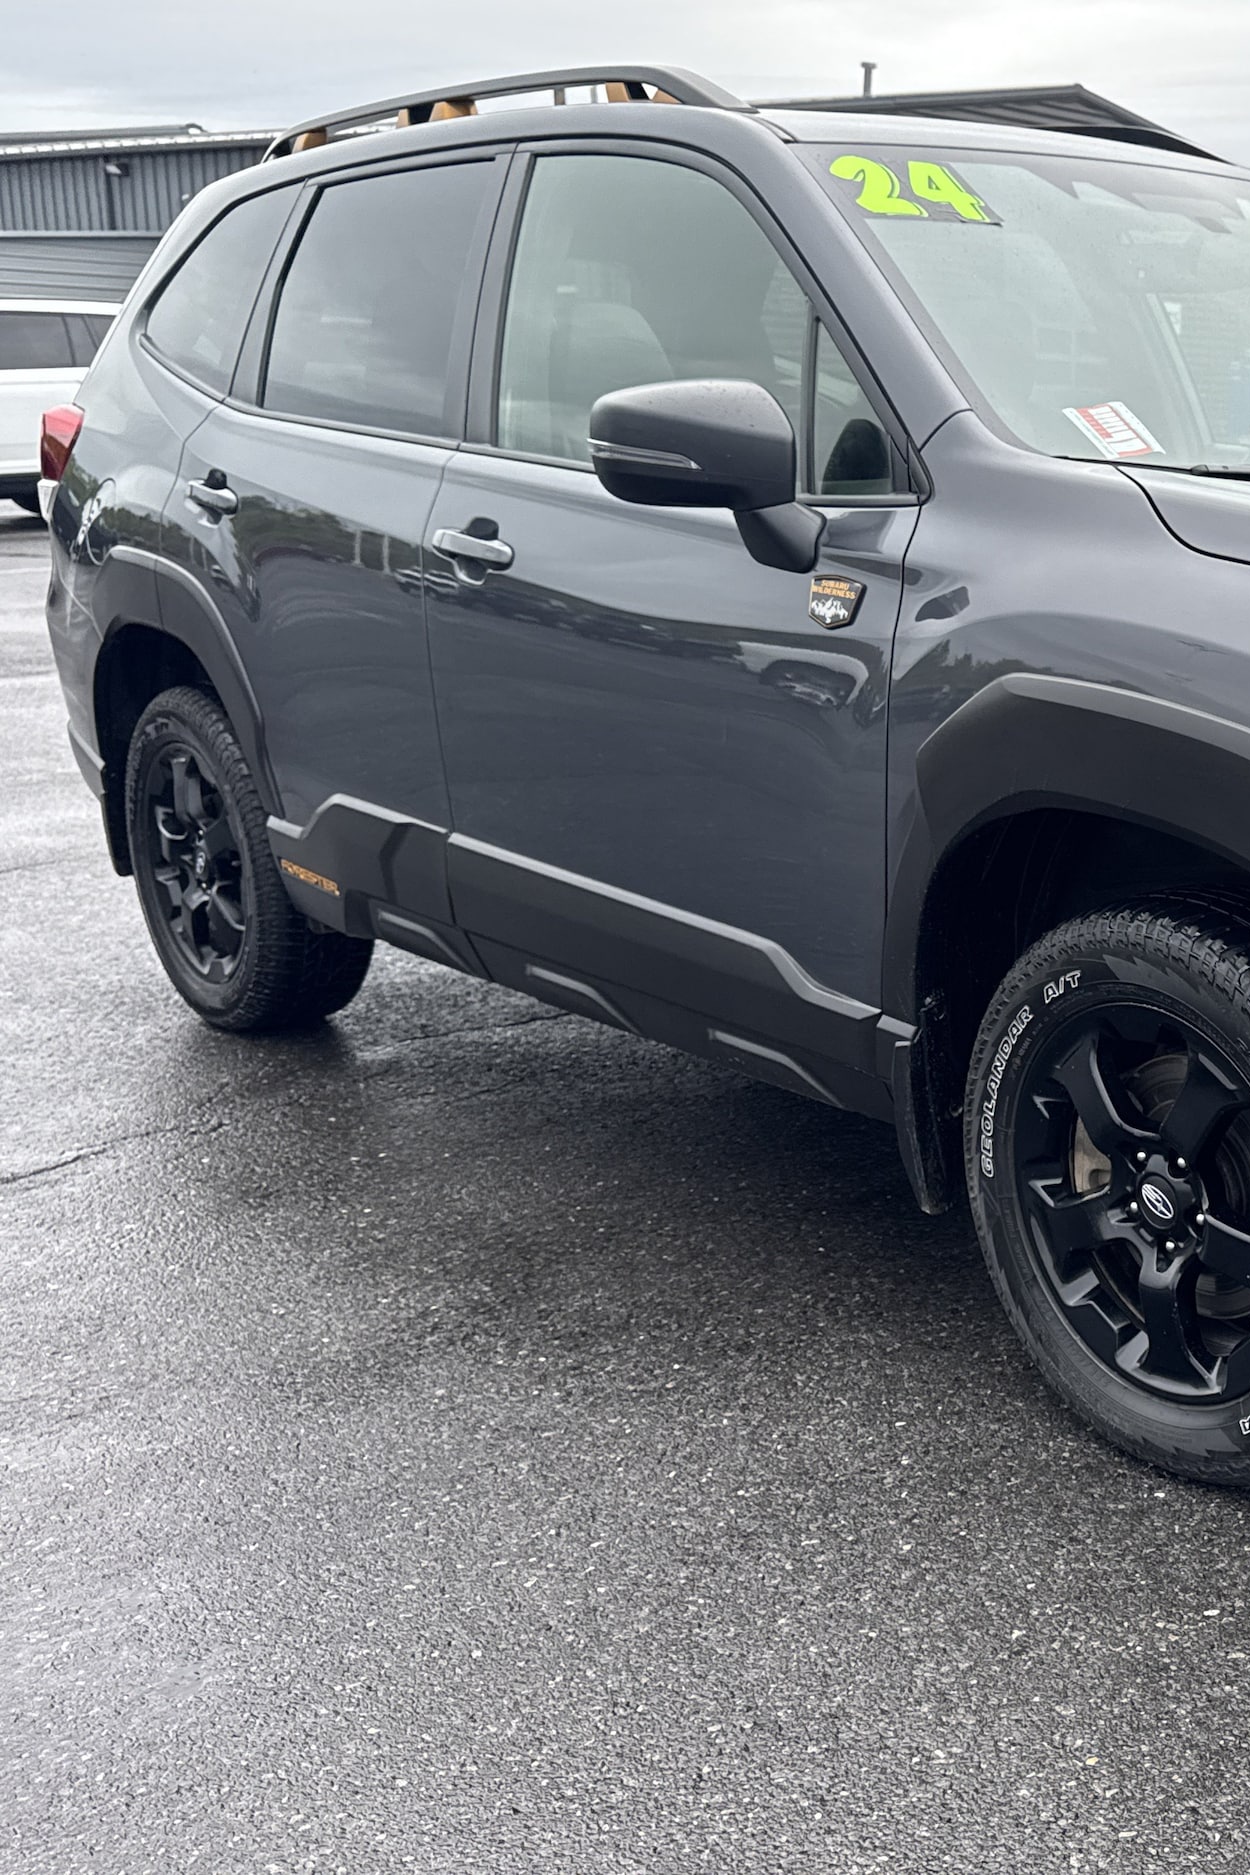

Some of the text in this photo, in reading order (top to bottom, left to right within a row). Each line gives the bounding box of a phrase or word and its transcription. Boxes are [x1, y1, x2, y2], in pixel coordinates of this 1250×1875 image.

[829, 155, 991, 223] 24
[812, 585, 856, 599] WILDERNESS
[821, 580, 849, 590] SUBARU
[981, 1004, 1034, 1178] GEOLANDAR
[1043, 969, 1081, 1004] A/T
